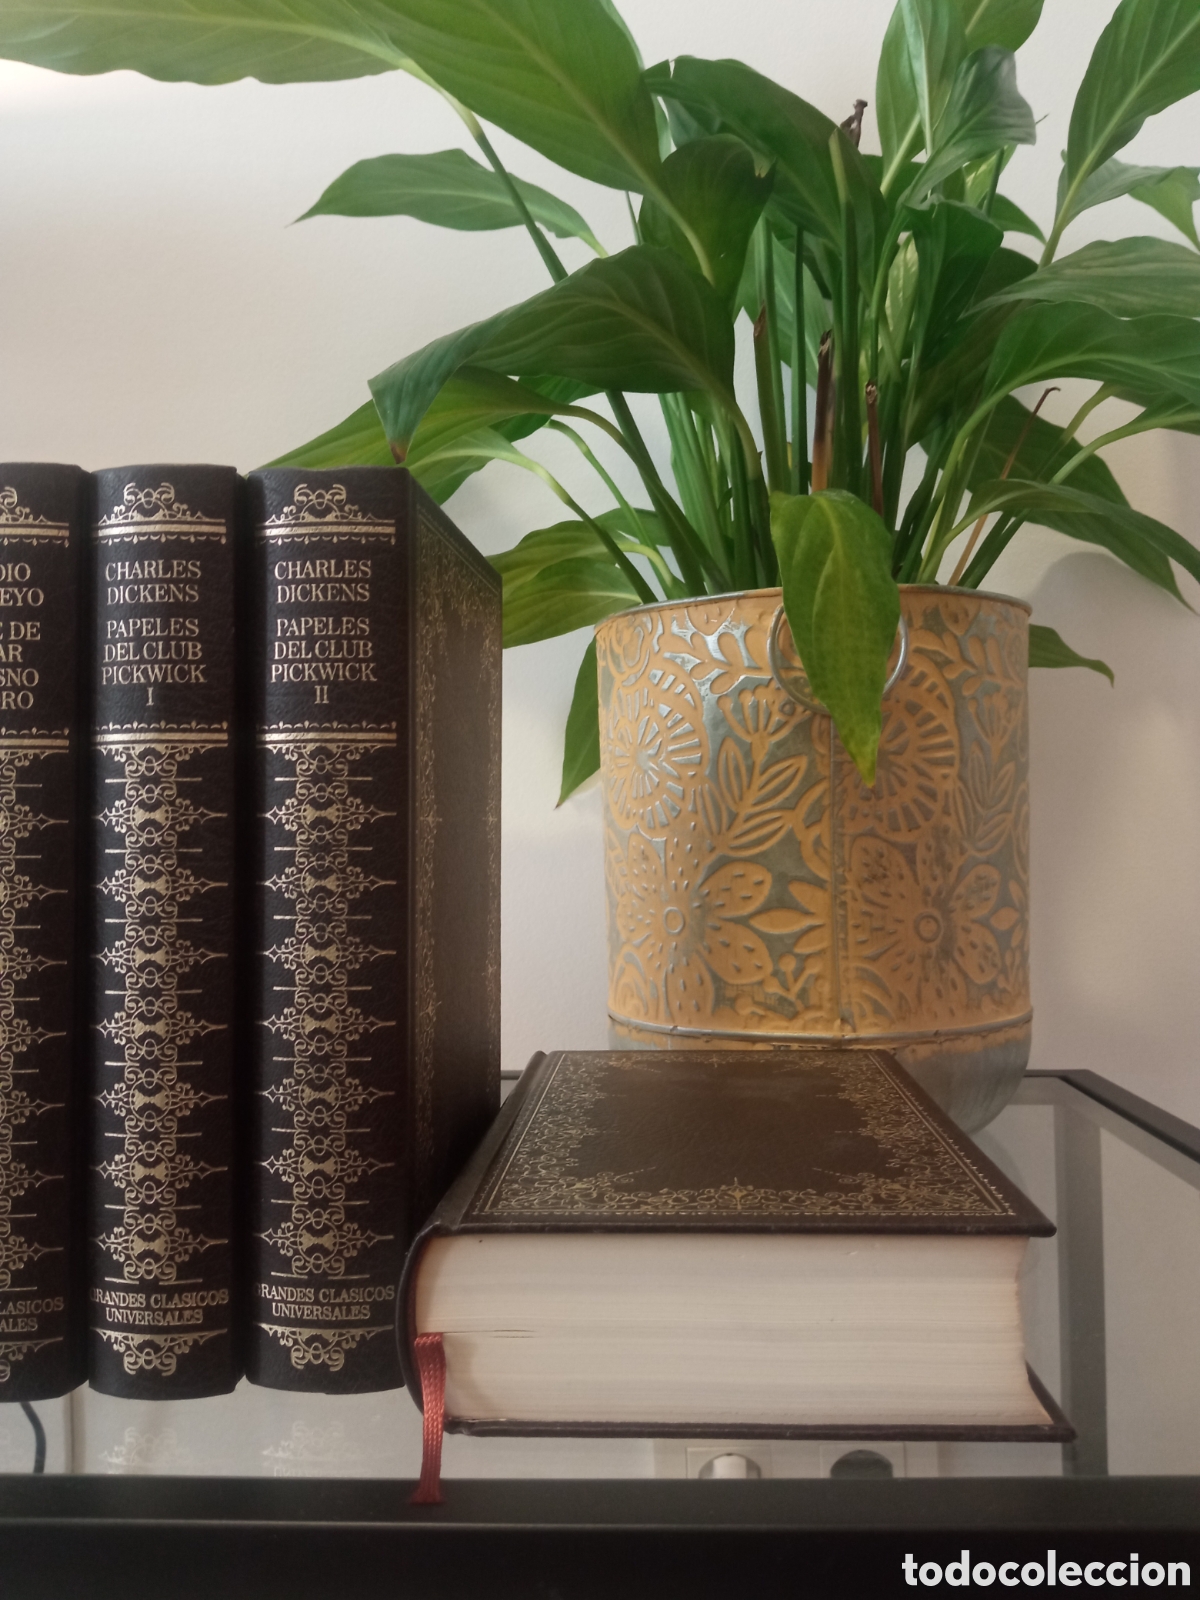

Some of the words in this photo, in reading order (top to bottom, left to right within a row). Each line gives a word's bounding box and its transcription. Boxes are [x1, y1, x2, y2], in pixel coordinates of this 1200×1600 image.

[105, 559, 202, 582] CHARLES
[274, 559, 372, 580] CHARLES
[106, 583, 199, 605] DICKENS
[276, 583, 370, 604] DICKENS
[9, 621, 41, 640] DE
[106, 618, 200, 639] PAPELES
[276, 617, 370, 637] PAPELES
[103, 642, 140, 663] DEL
[143, 641, 202, 660] CLUB
[273, 640, 312, 660] DEL
[315, 639, 373, 659] CLUB
[101, 664, 207, 685] PICKWICK
[270, 662, 377, 683] PICKWICK
[146, 687, 155, 706] I
[314, 685, 330, 704] II
[151, 1288, 230, 1308] CLASICOS
[319, 1284, 395, 1303] CLASICOS
[105, 1307, 204, 1326] UNIVERSALES
[272, 1302, 371, 1321] UNIVERSALES
